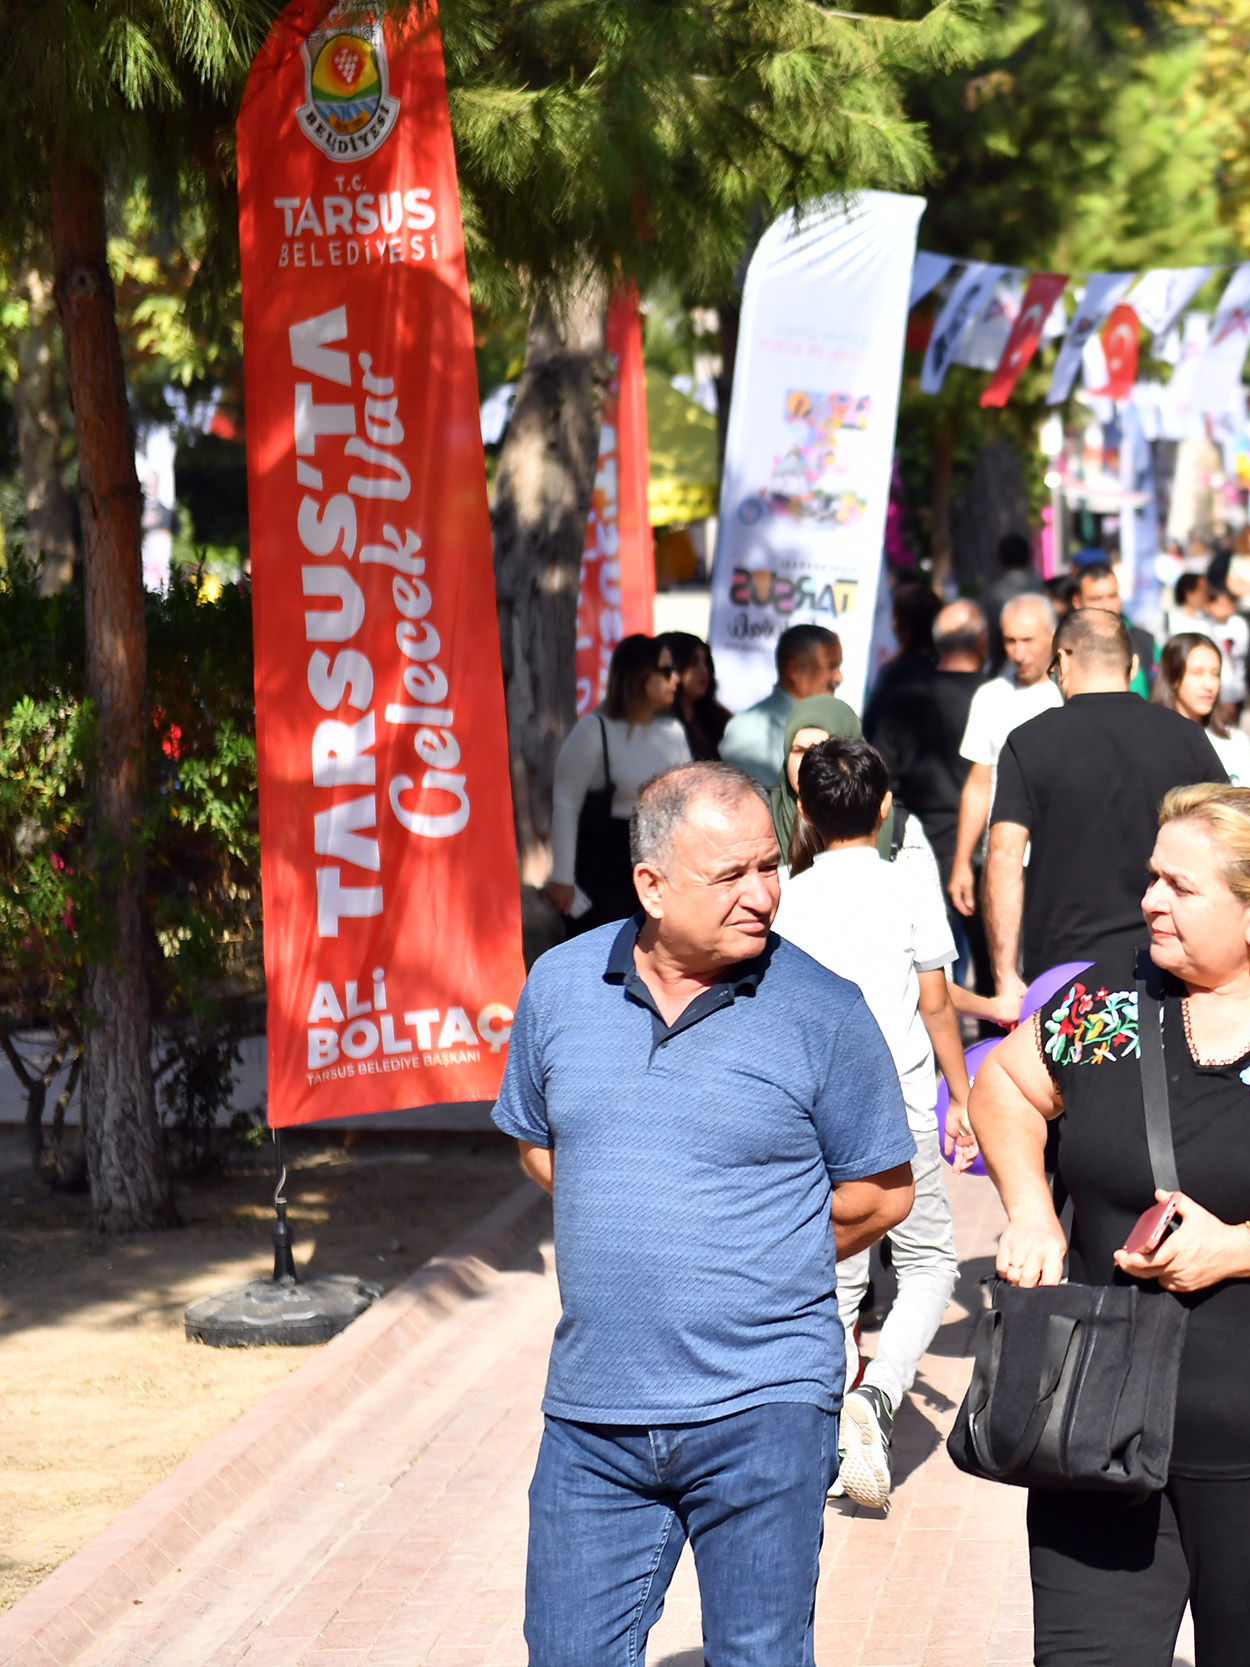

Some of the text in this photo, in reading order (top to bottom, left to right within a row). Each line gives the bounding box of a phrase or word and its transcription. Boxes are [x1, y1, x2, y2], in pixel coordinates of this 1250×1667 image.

[335, 174, 367, 192] T.C.
[273, 187, 436, 237] TARSUS
[278, 233, 438, 267] BELEDİYESİ
[288, 303, 385, 938] TARSUS'TA
[343, 350, 470, 838] Gelecek Var
[307, 966, 388, 1024] ALİ
[307, 1002, 514, 1070] BOLTAÇ
[306, 1064, 355, 1086] TARSUS
[423, 1050, 482, 1069] BAŞKANI
